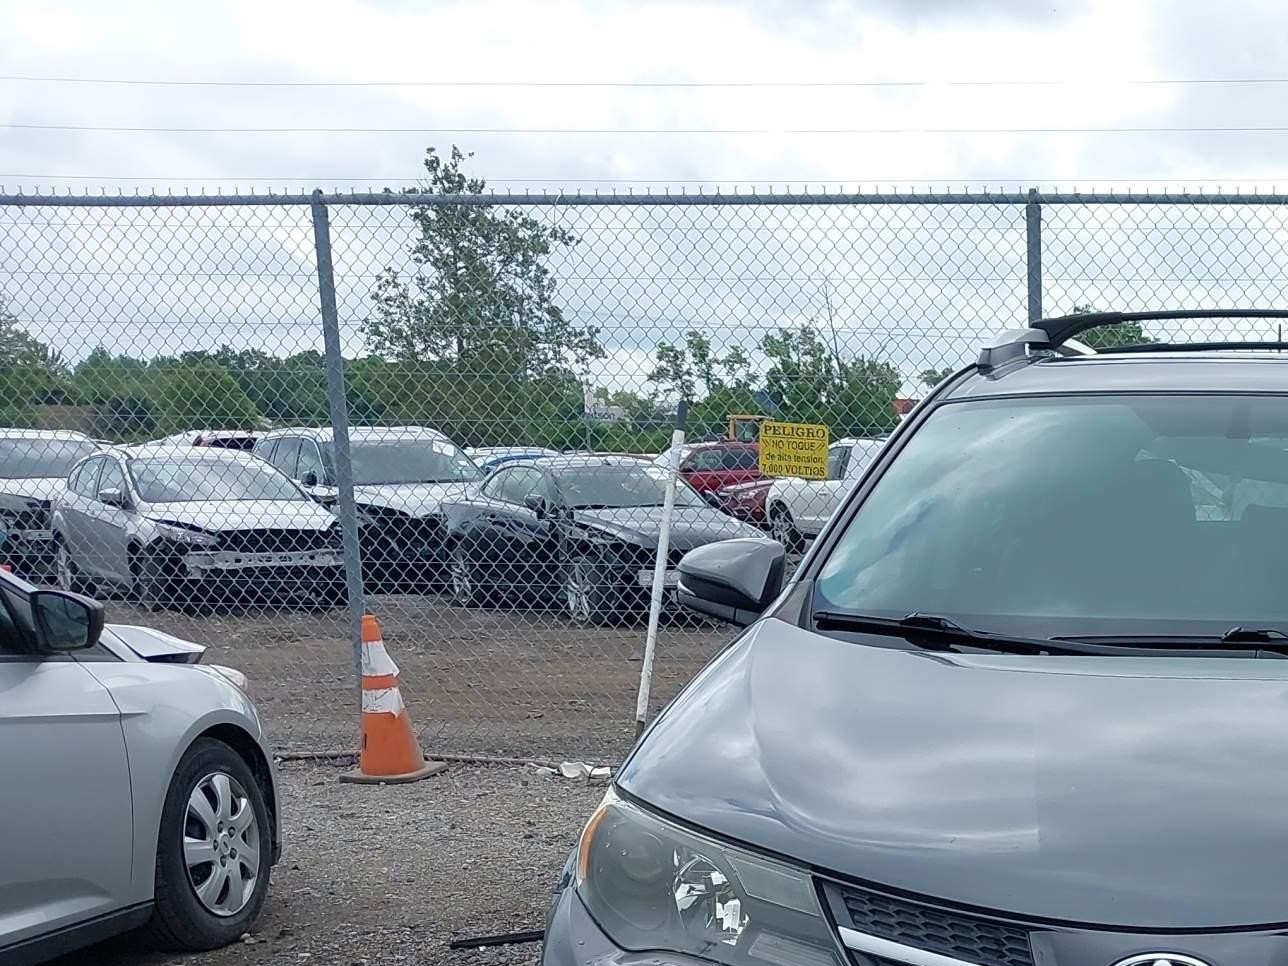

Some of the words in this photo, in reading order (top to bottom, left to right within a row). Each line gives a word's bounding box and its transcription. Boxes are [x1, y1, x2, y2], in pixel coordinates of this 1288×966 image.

[764, 425, 826, 439] PELIGRO
[772, 440, 785, 450] NO
[787, 441, 816, 451] TOQUE
[766, 452, 776, 461] de
[777, 453, 792, 462] alta
[762, 463, 783, 474] 7,000
[785, 465, 825, 476] VOLTIOS
